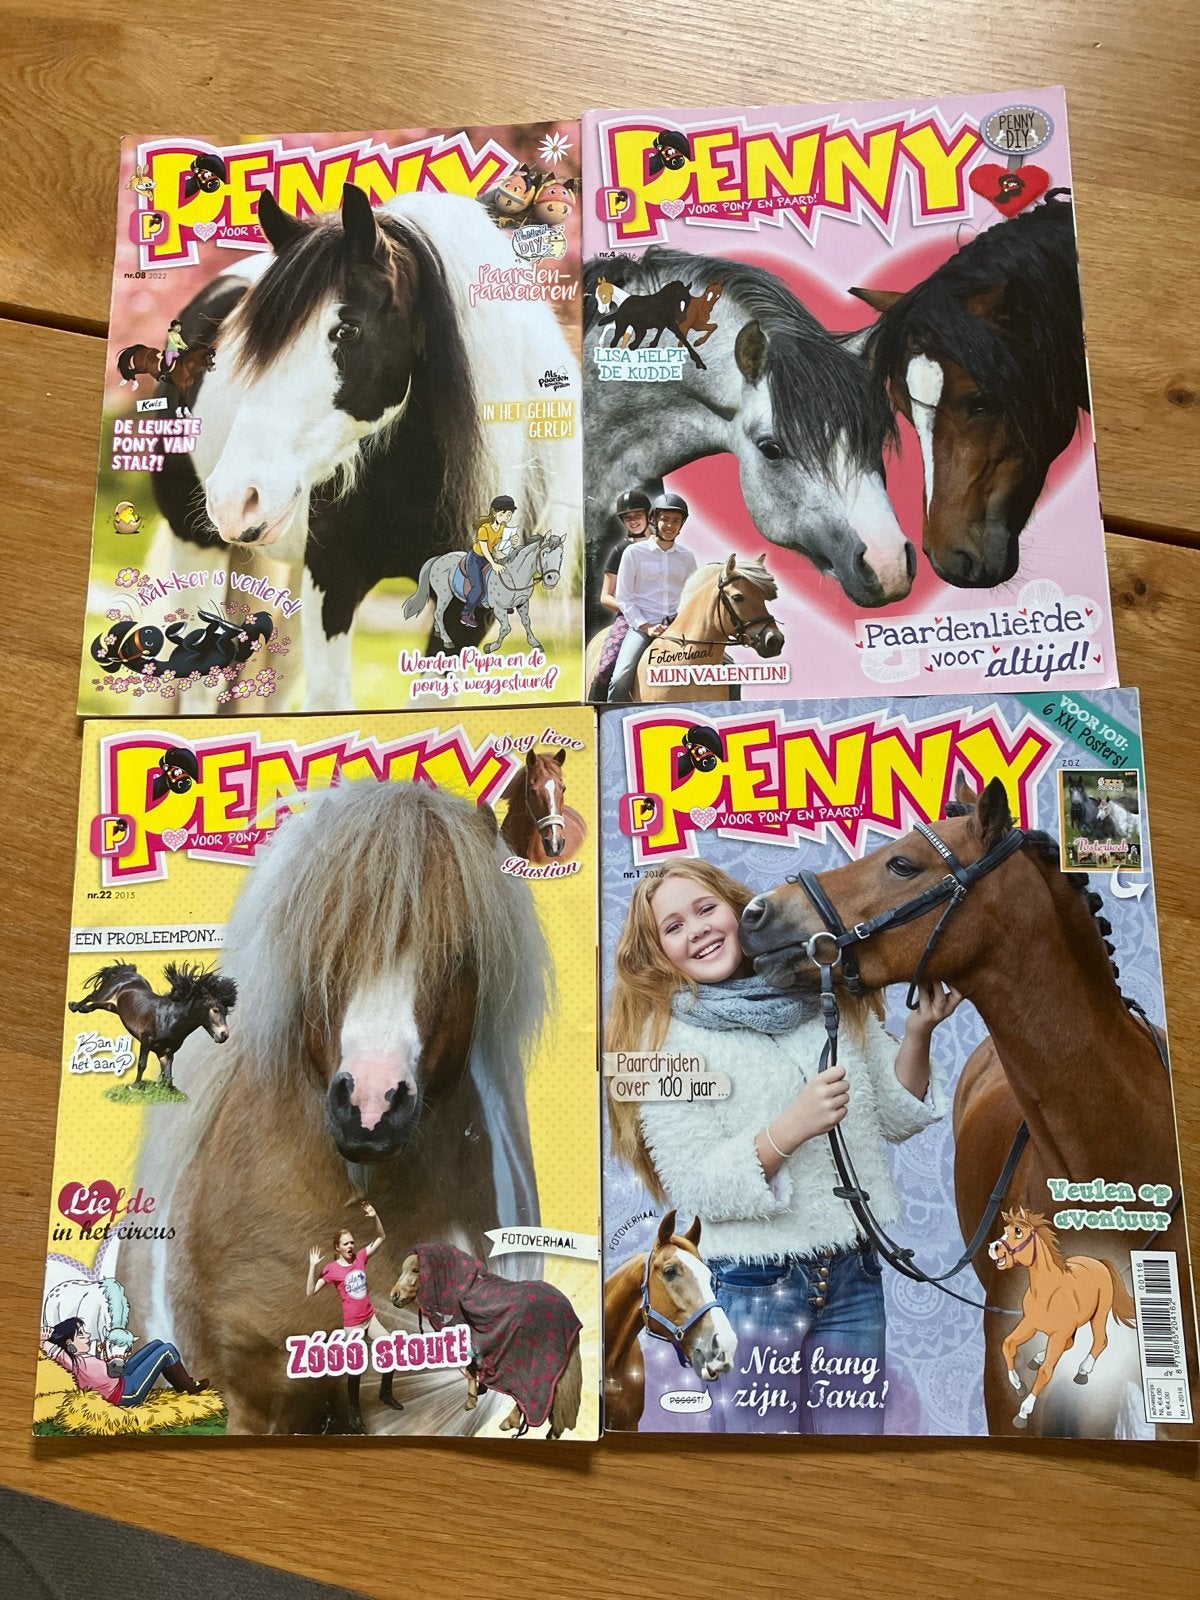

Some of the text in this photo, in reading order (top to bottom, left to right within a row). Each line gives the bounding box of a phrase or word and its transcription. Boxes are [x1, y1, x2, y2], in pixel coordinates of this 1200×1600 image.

[998, 113, 1035, 130] PENNY
[1005, 129, 1029, 148] DIY
[611, 124, 983, 236] PENNY
[688, 194, 818, 215] VOOR PONY EN PAARD!
[219, 226, 249, 238] VOOR
[518, 237, 543, 254] DIY
[123, 271, 146, 280] nr.08
[479, 262, 571, 284] Paarden-
[469, 281, 579, 307] paaseieren!
[595, 348, 685, 362] LISA HELPT
[544, 370, 557, 379] Als
[601, 365, 681, 380] DE KUDDE
[141, 400, 162, 410] Kwis
[483, 401, 573, 420] IN HET GEHEIM
[114, 419, 202, 435] DE LEUKSTE
[529, 420, 573, 438] GERED!
[112, 436, 196, 453] PONY VAN
[112, 454, 165, 471] STAL?!
[138, 570, 302, 618] Rakker is verliefd!
[865, 602, 1086, 649] Paardenliefde
[401, 648, 544, 672] Worden Pippa en de
[648, 646, 714, 665] Fotoverhaal
[932, 641, 1090, 682] voor altijd!
[413, 667, 559, 697] pony's weggestuurd?
[650, 666, 787, 682] MIJN VALENTIJN!
[1060, 694, 1129, 751] VOOR JOU:
[494, 727, 582, 757] Dag lieve
[1042, 703, 1129, 768] 6 XXL Posters!
[635, 720, 1049, 850] PENNY
[720, 803, 864, 826] VOOR PONY EN PAARD!
[191, 834, 223, 846] VOOR
[229, 831, 261, 844] PONY
[502, 857, 578, 879] Bastion
[623, 869, 665, 879] nr.1 2016
[87, 891, 136, 900] nr.22 2015
[75, 929, 224, 946] EEN PROBLEEMPONY...
[78, 1033, 129, 1052] Kan jij
[71, 1054, 132, 1073] het aan?
[617, 1053, 700, 1077] Paardrijden
[616, 1081, 651, 1096] over
[658, 1076, 683, 1097] 100
[1049, 1180, 1171, 1204] Veulen op
[64, 1187, 156, 1223] Liefde
[1055, 1208, 1169, 1228] avontuur
[52, 1220, 176, 1241] in het circus
[608, 1209, 660, 1251] FOTOVERHAAL
[501, 1233, 578, 1250] FOTOVERHAAL
[1136, 1261, 1146, 1290] 00116
[290, 1326, 469, 1374] Zóóó stout!
[740, 1346, 881, 1384] Niet bang
[731, 1379, 890, 1417] zijn, Tara!
